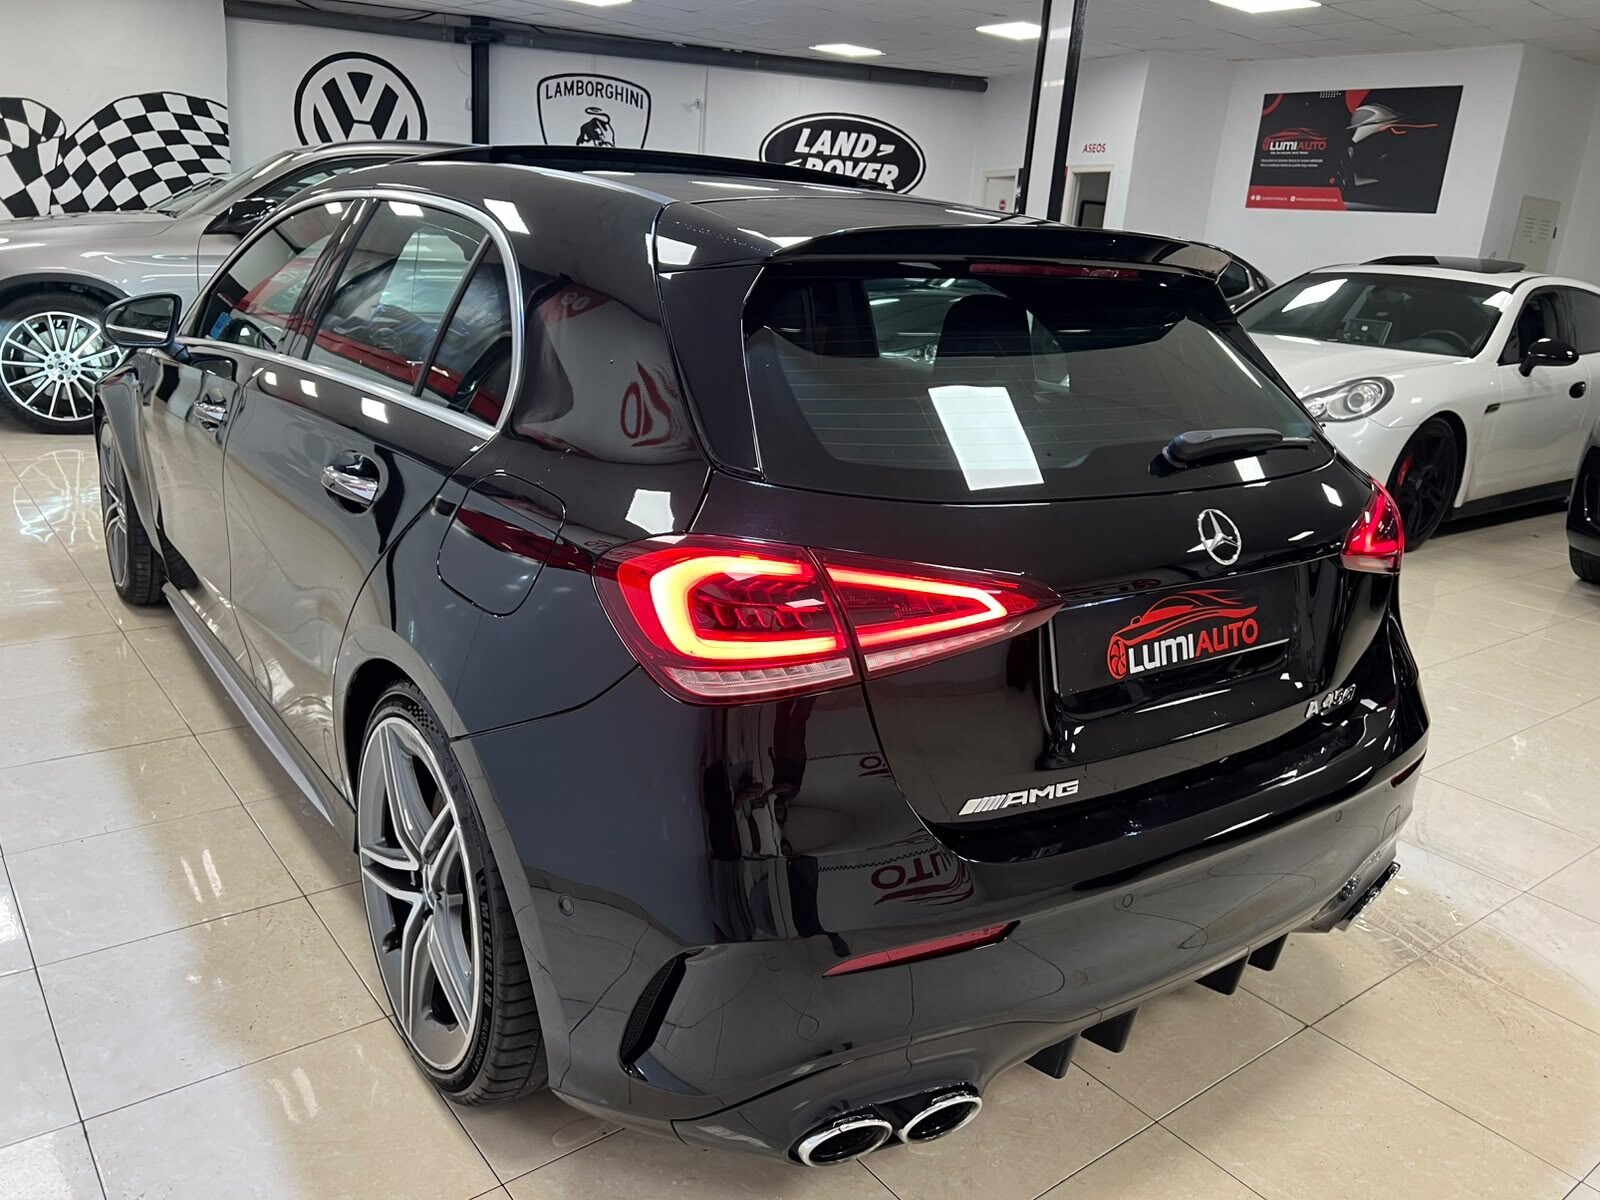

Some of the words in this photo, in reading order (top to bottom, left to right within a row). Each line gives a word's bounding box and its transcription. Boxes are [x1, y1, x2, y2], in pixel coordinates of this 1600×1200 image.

[545, 80, 644, 110] LAMBORGHINI
[794, 128, 877, 158] LAND
[1083, 143, 1106, 154] ASEOS
[1000, 780, 1080, 809] AMG
[480, 900, 493, 1008] MICHELIN
